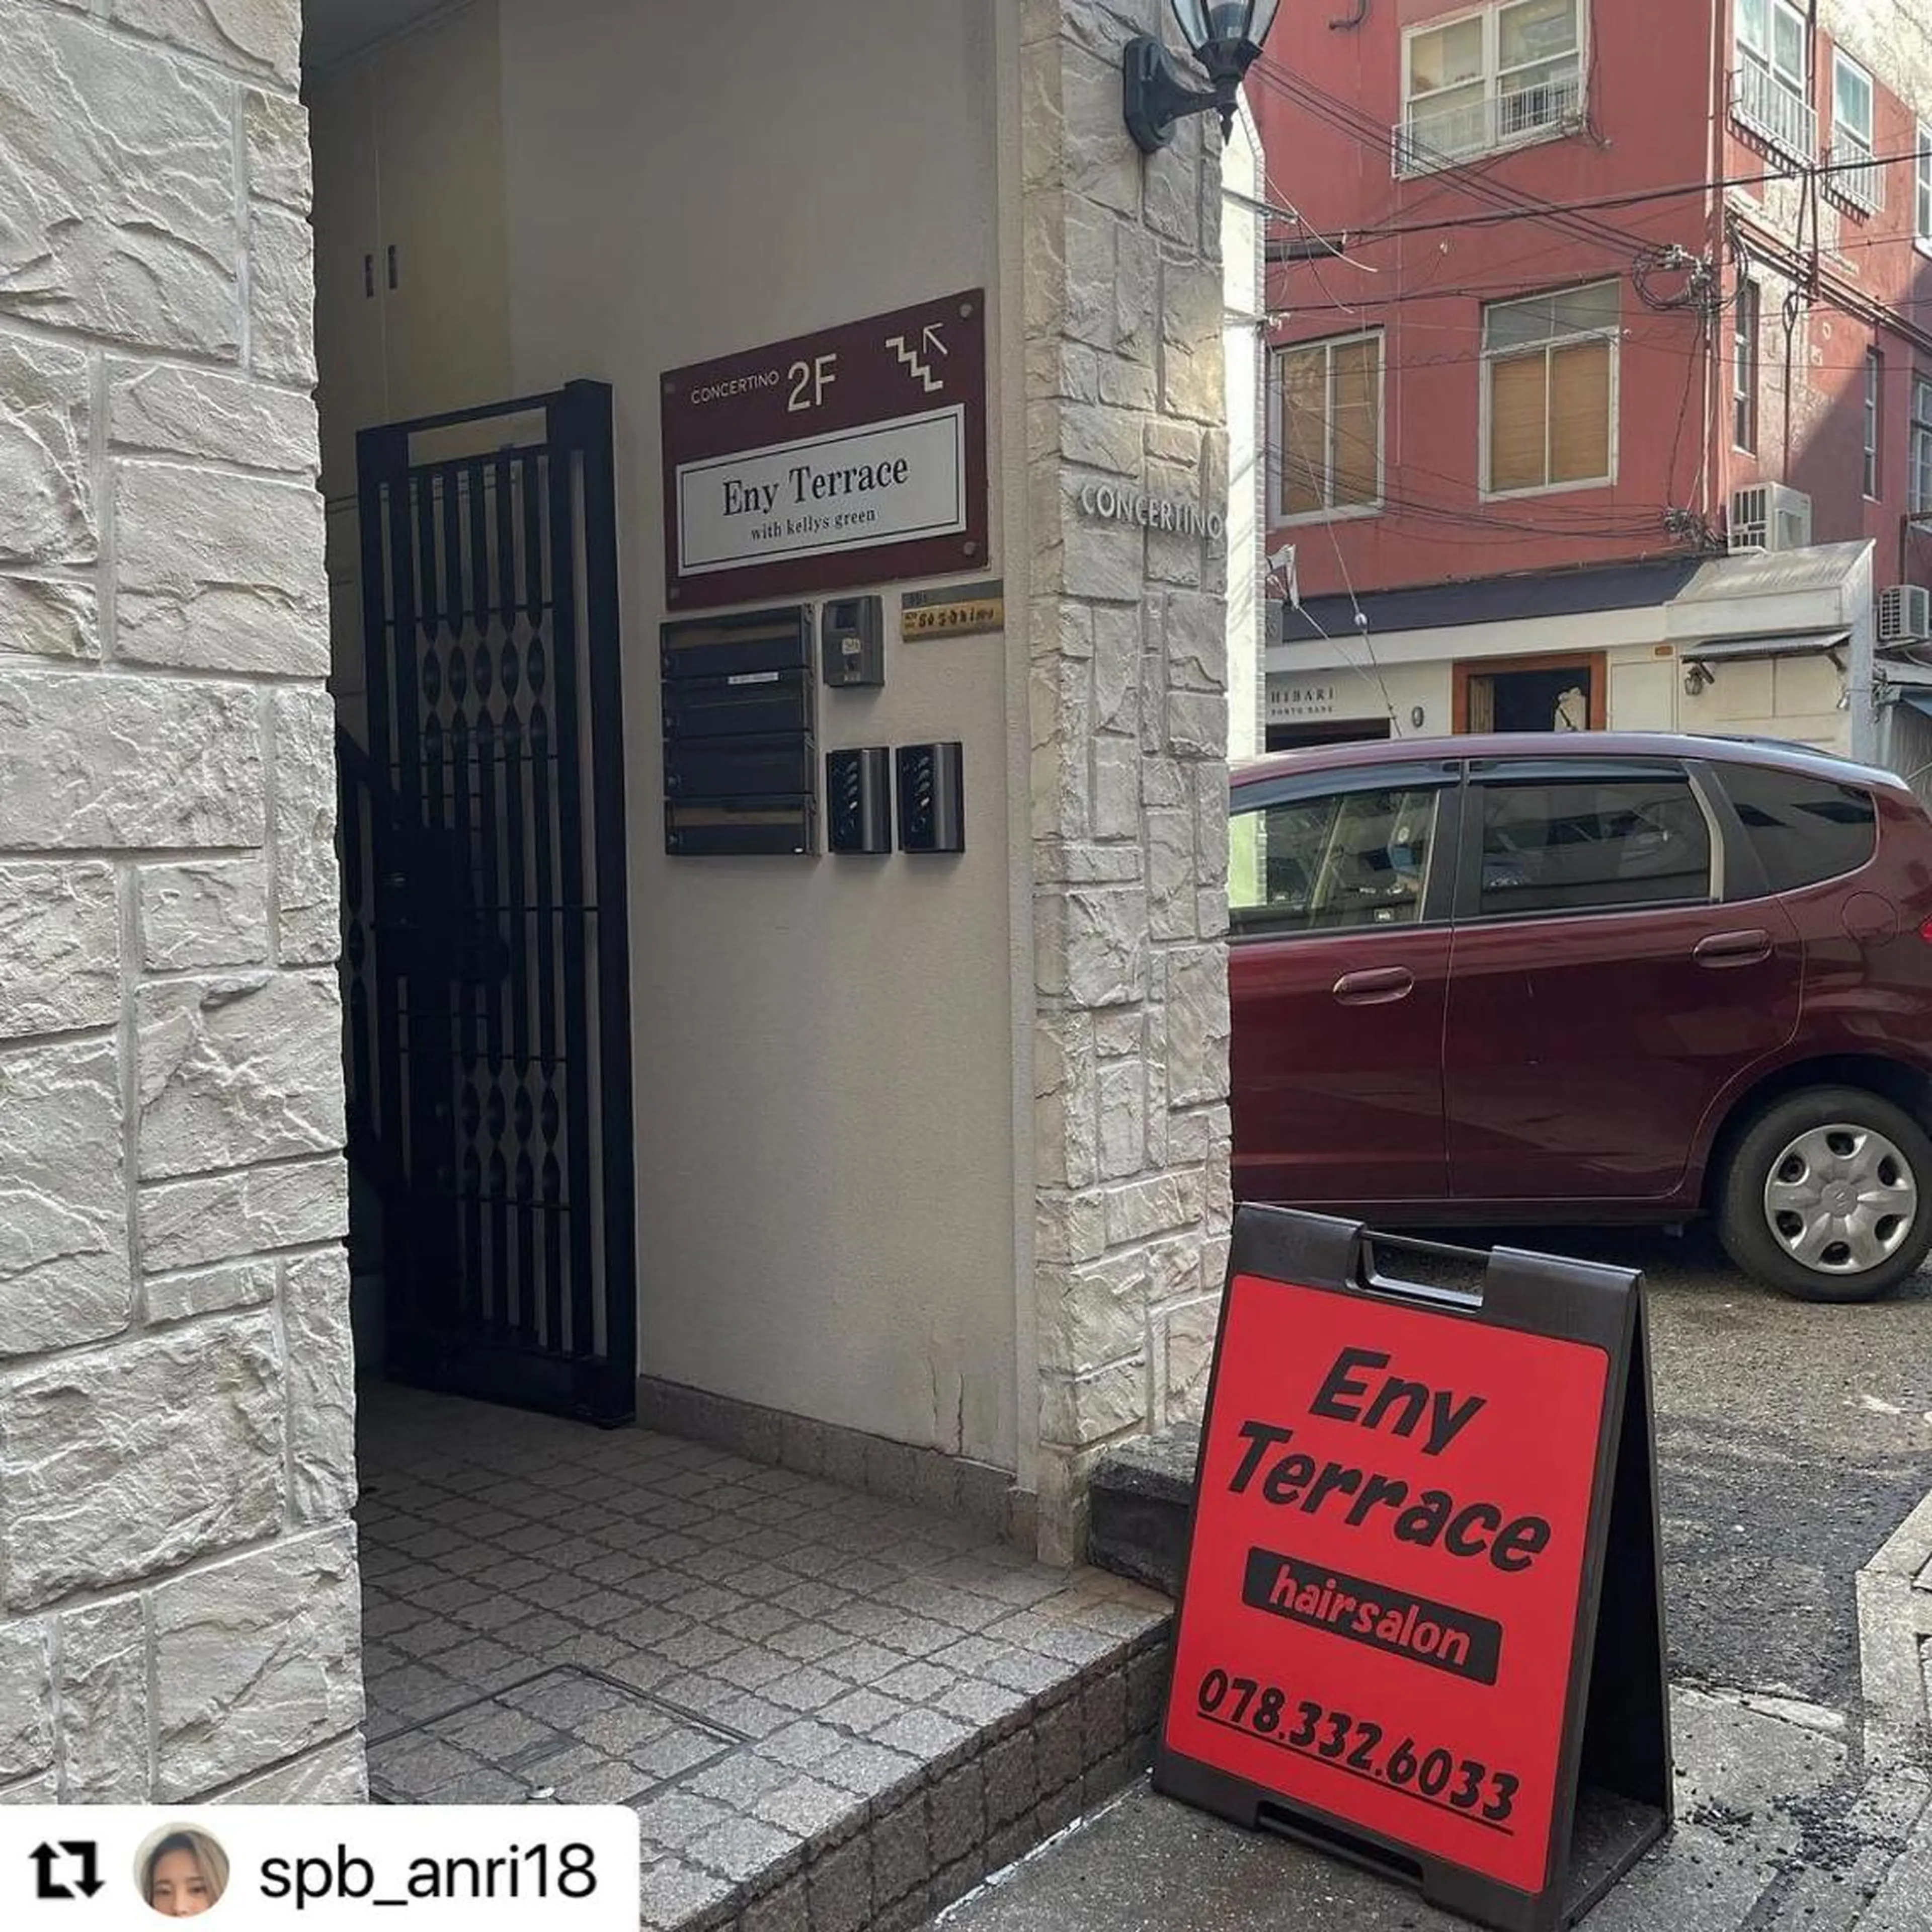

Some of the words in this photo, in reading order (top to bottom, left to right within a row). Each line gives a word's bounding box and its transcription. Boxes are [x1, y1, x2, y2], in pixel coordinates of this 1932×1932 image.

[691, 370, 779, 404] CONCERTINO
[787, 353, 837, 412] 2F
[722, 479, 779, 516] Eny
[788, 457, 908, 504] Terrace
[751, 523, 781, 541] with
[786, 516, 830, 535] kellys
[835, 509, 876, 529] green
[1081, 484, 1224, 539] CONCERTINO
[1308, 1346, 1487, 1457] Eny
[1227, 1420, 1552, 1573] Terrace
[1269, 1564, 1471, 1666] hairsalon
[1197, 1668, 1520, 1822] 078.332.6033
